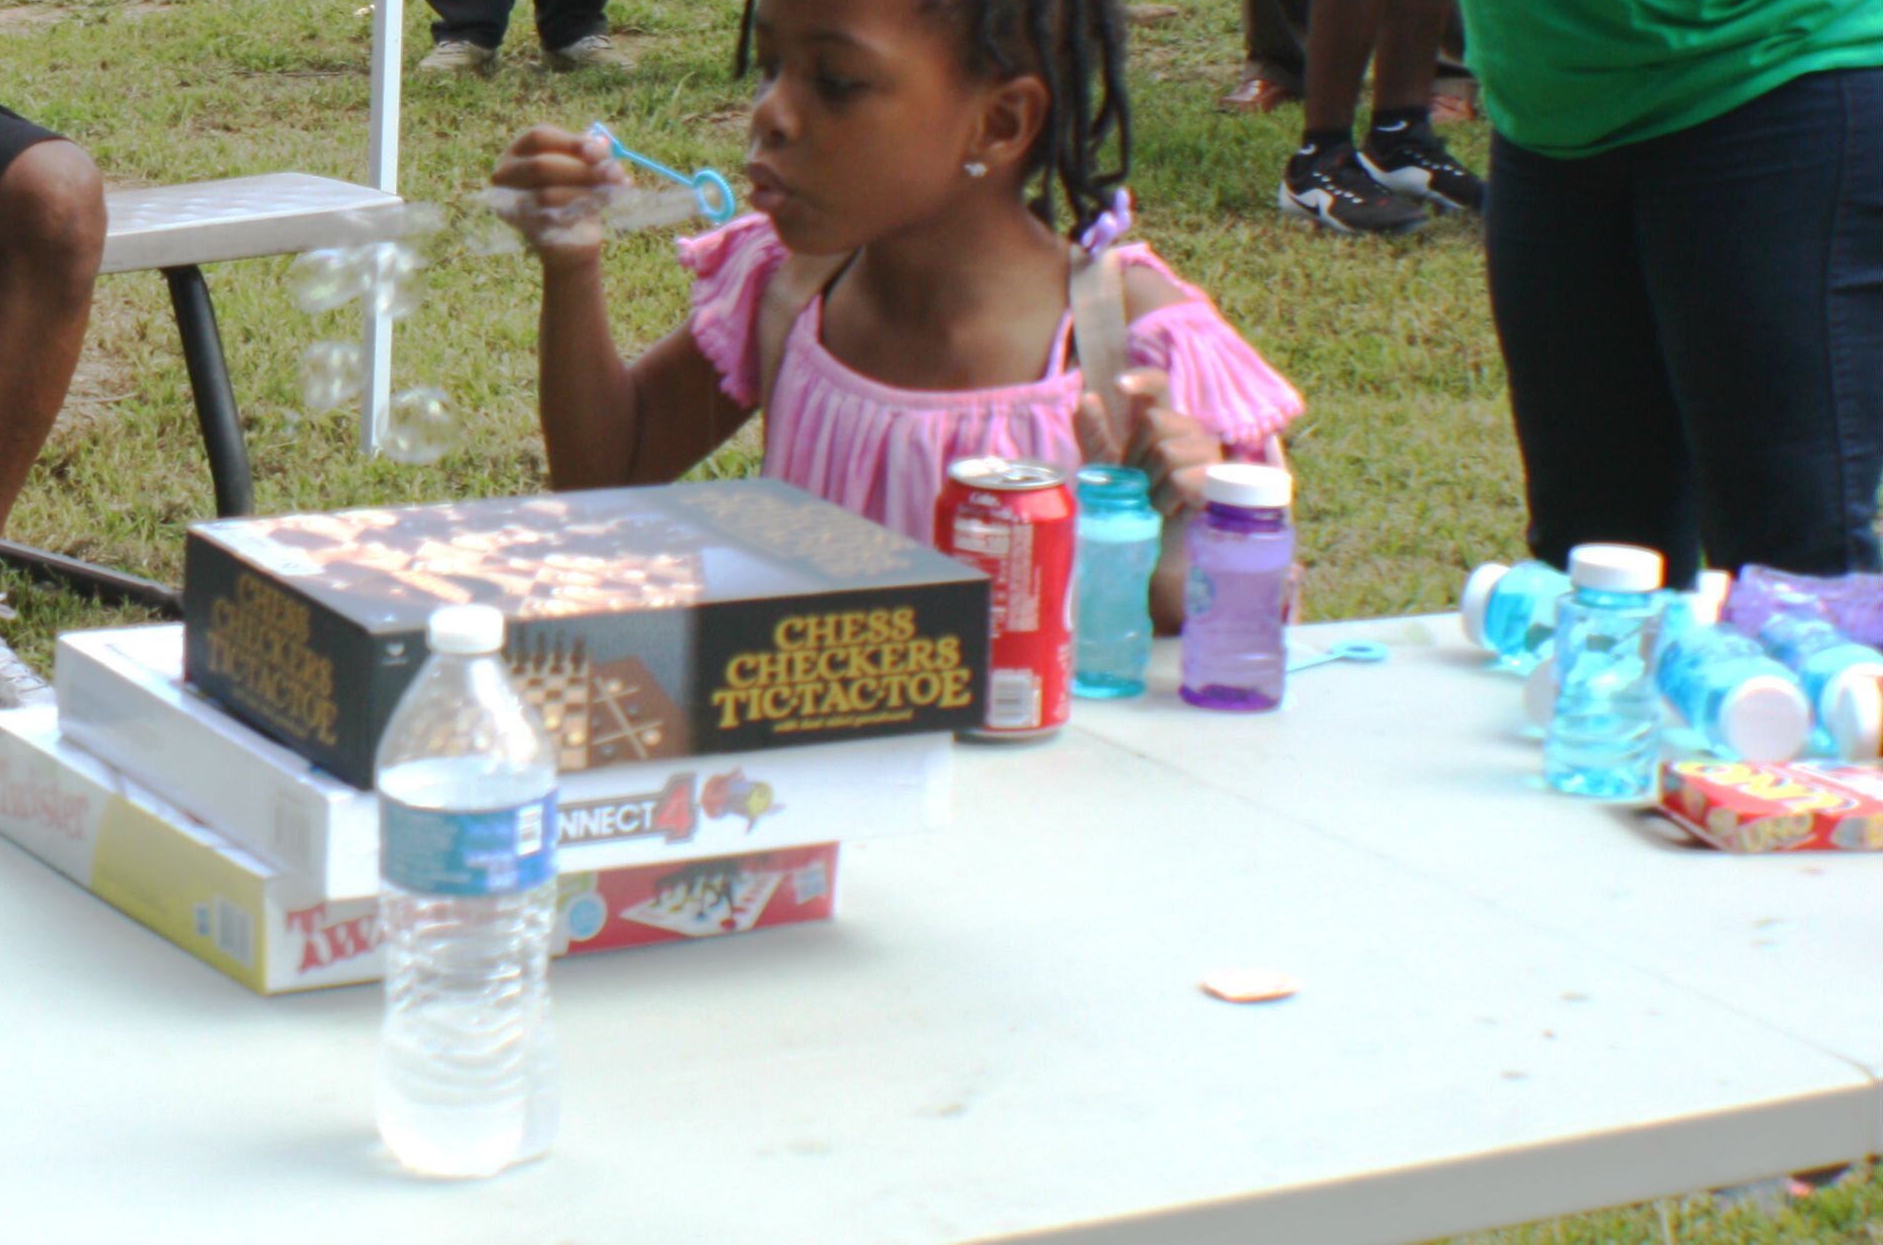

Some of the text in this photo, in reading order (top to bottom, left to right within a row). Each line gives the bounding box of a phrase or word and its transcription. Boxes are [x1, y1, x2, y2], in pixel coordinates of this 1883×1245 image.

[774, 608, 916, 652] CHESS
[726, 635, 962, 688] CHECKERS
[557, 784, 692, 839] NNECT 4
